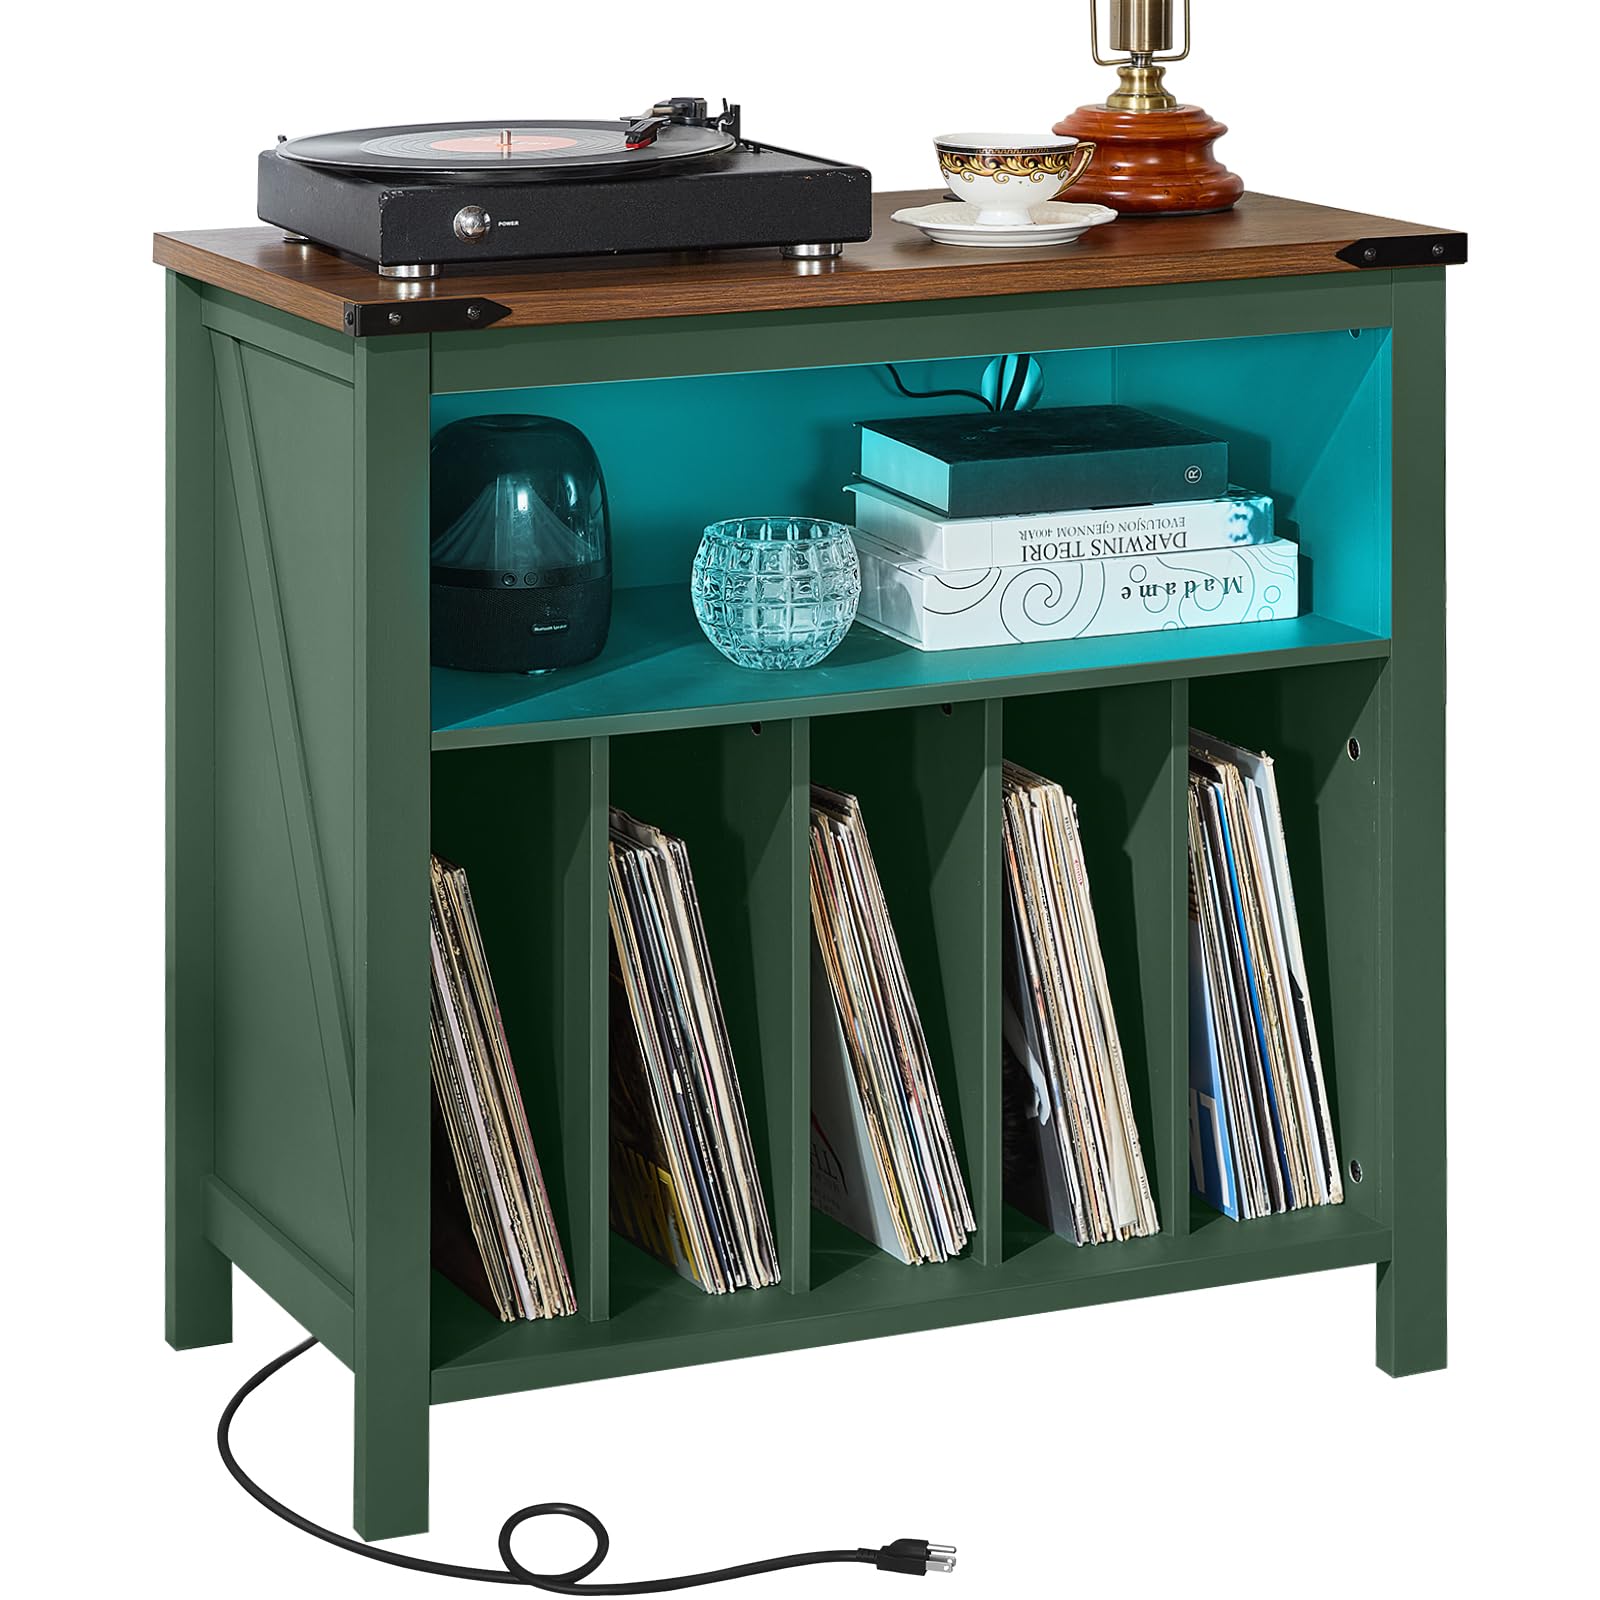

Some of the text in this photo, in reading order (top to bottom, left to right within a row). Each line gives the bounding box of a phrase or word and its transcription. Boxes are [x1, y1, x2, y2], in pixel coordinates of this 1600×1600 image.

[1056, 520, 1114, 538] GJENNOM
[1118, 516, 1186, 532] EVOLUSJON
[1022, 532, 1187, 562] DARWINS TEORI
[1121, 575, 1244, 600] Madame
